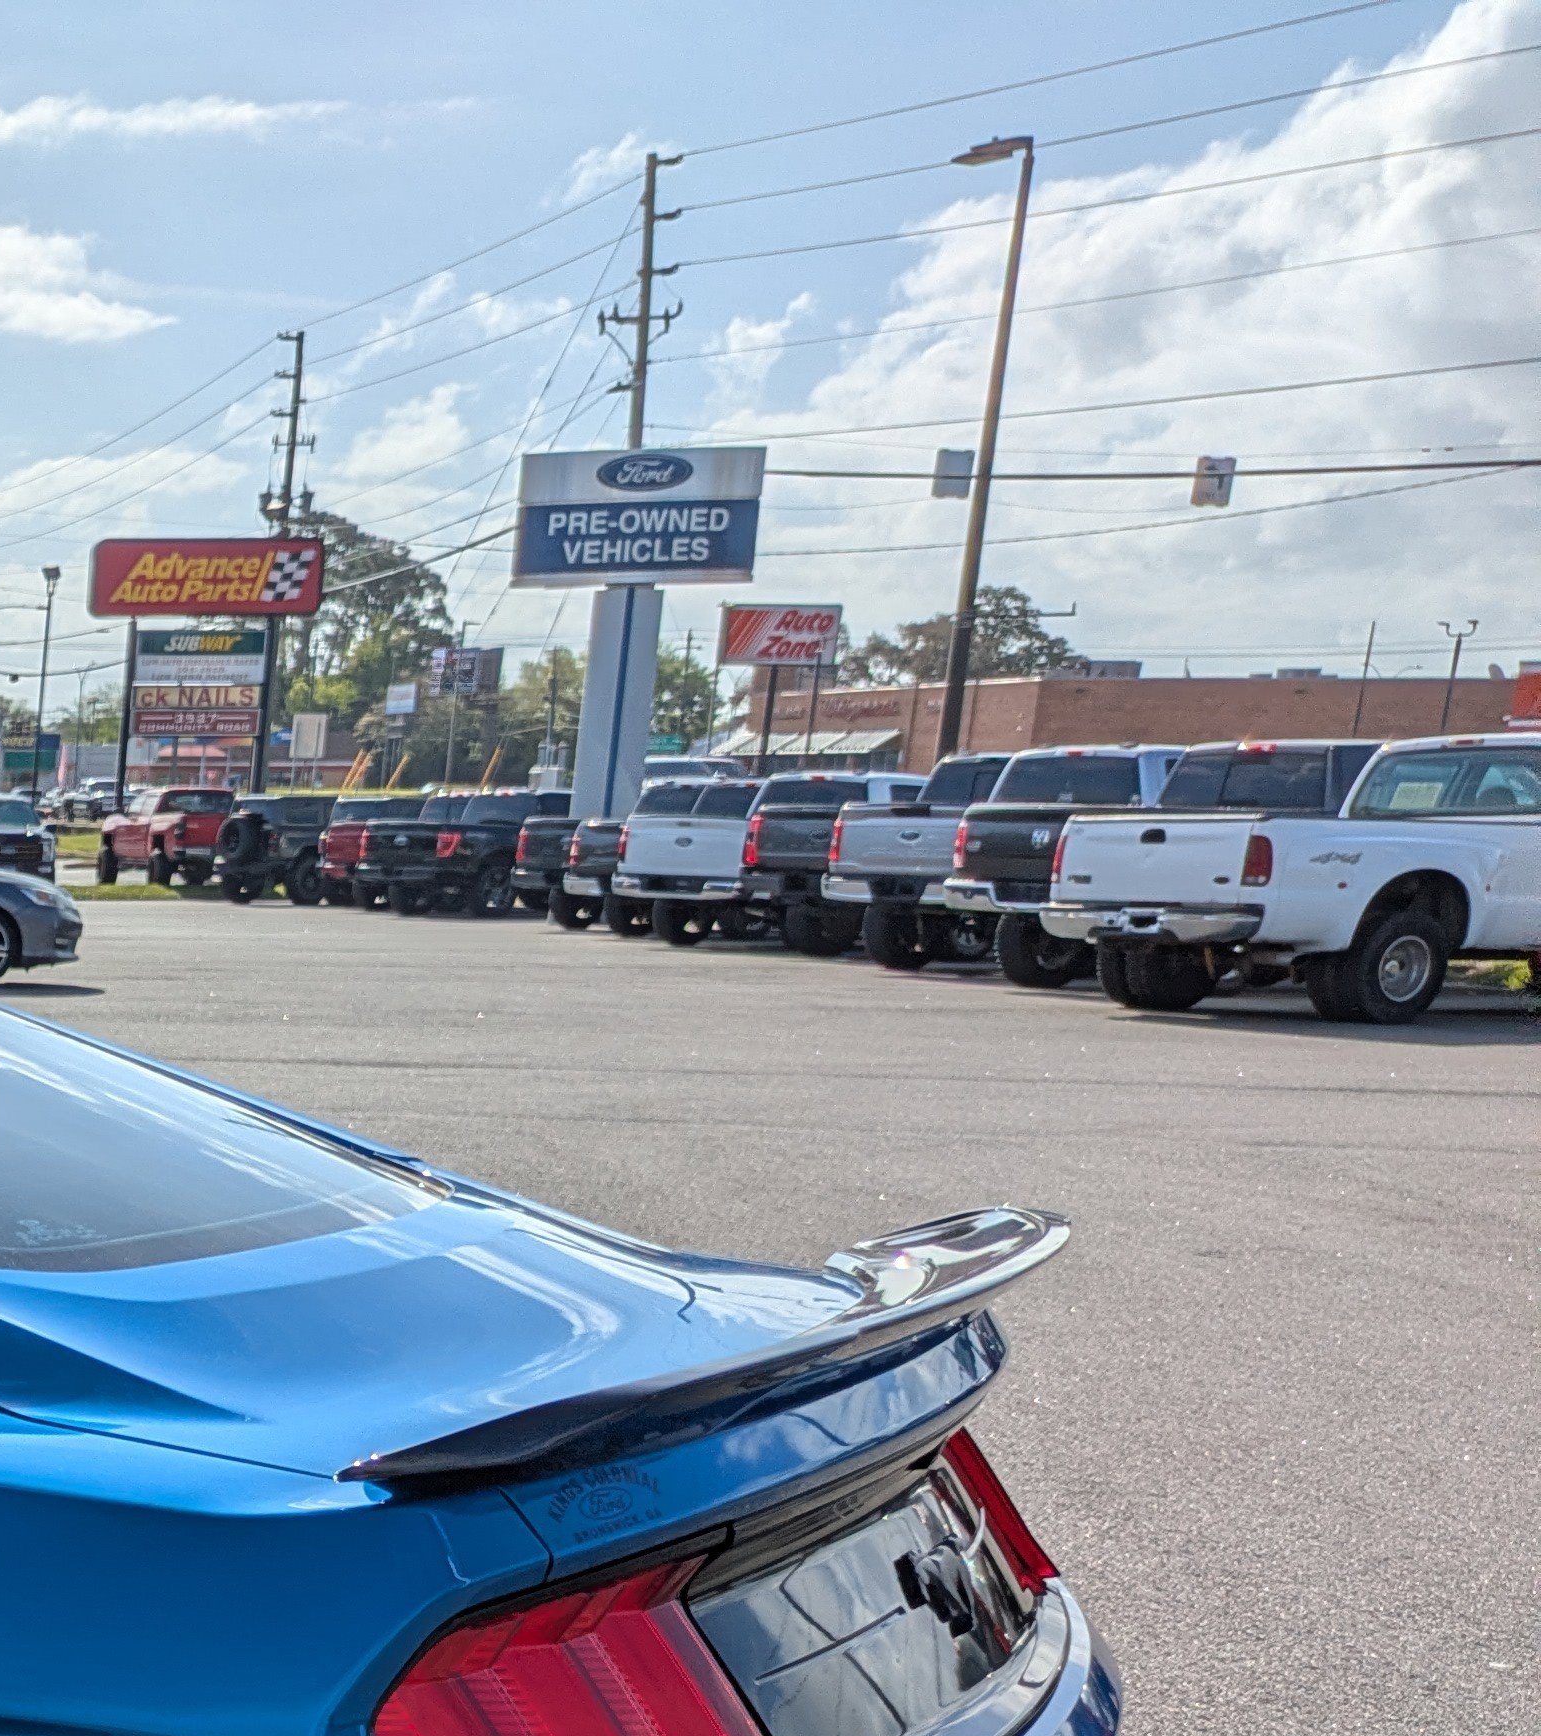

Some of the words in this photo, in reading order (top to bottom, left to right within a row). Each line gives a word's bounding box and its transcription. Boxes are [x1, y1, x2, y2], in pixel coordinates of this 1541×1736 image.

[616, 459, 678, 485] Ford
[547, 507, 730, 536] PRE-OWNED
[563, 537, 710, 565] VEHICLES
[127, 551, 262, 580] Advance
[109, 580, 179, 603] Auto
[178, 579, 252, 603] Parts
[774, 610, 834, 633] Auto
[163, 635, 242, 652] SUBWAY
[757, 636, 822, 658] Zone
[178, 687, 254, 707] NAILS
[138, 722, 212, 733] COMMUNITY
[216, 722, 251, 732] ROAD
